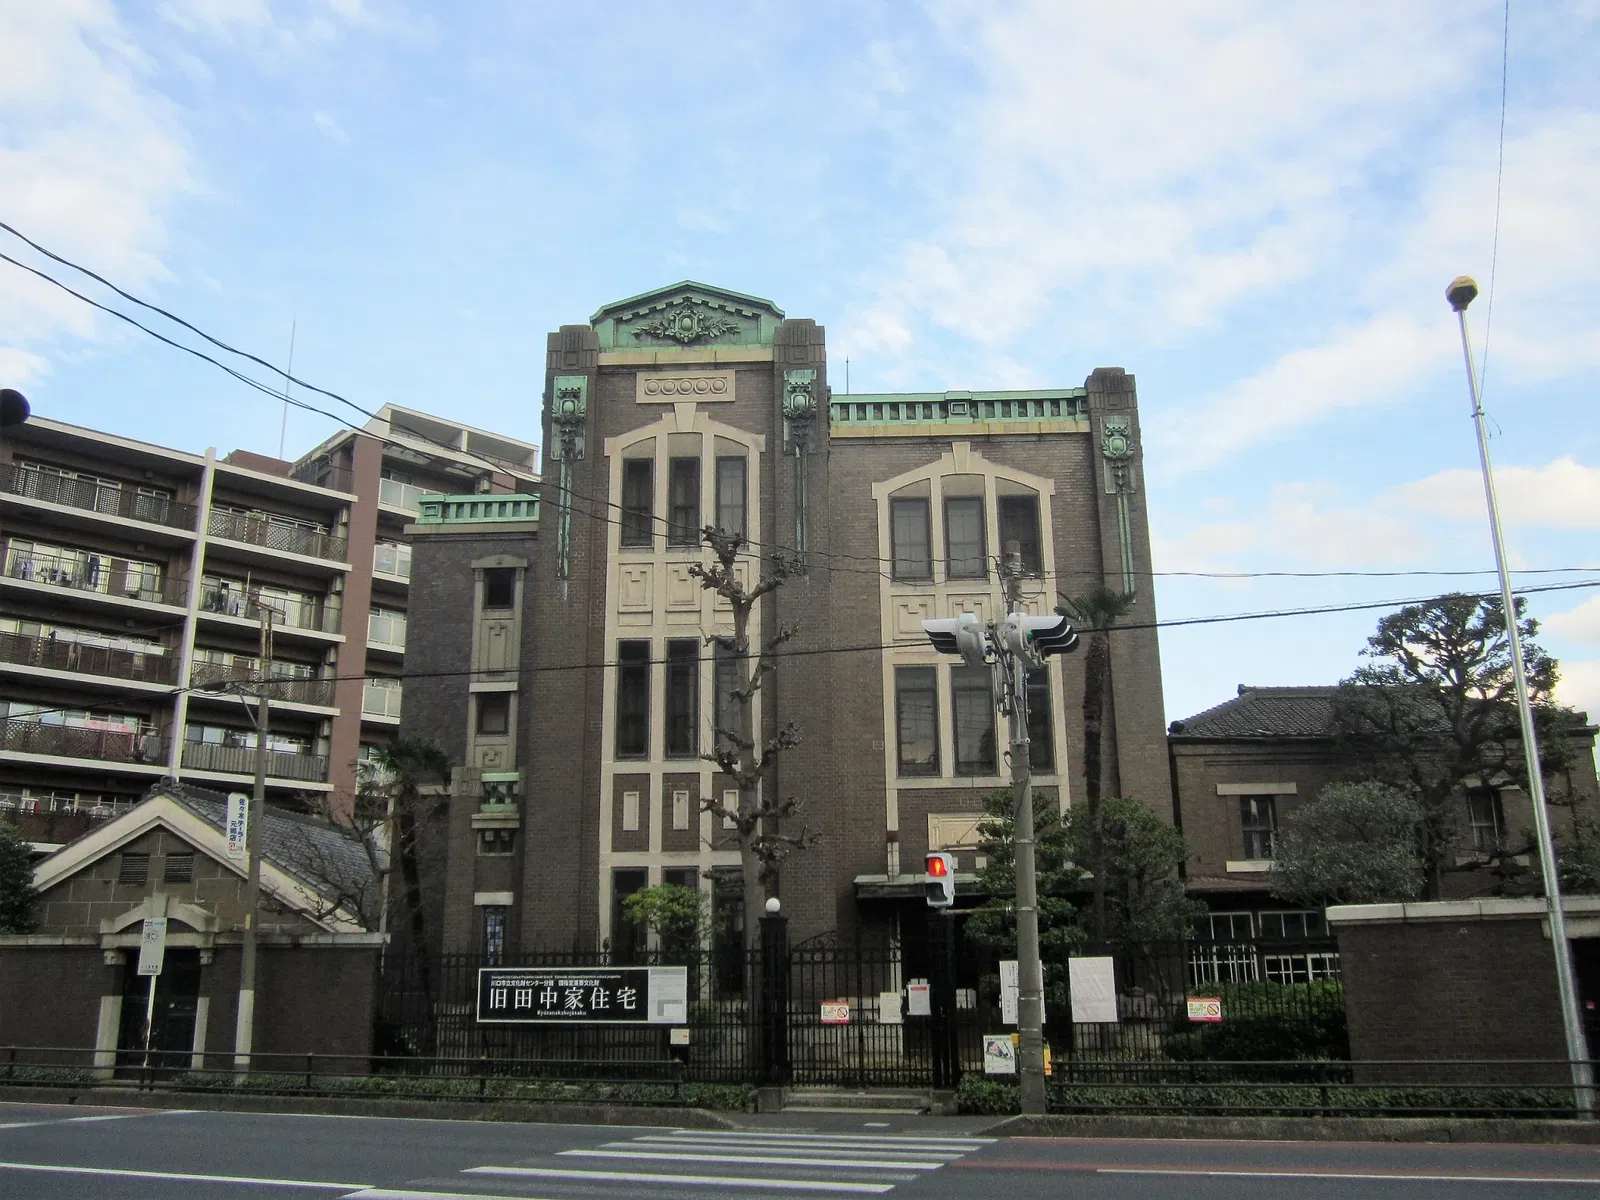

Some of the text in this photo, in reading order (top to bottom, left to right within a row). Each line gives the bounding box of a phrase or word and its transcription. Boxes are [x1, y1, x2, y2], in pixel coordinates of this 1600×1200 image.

[489, 987, 636, 1010] 旧田中家住宅
